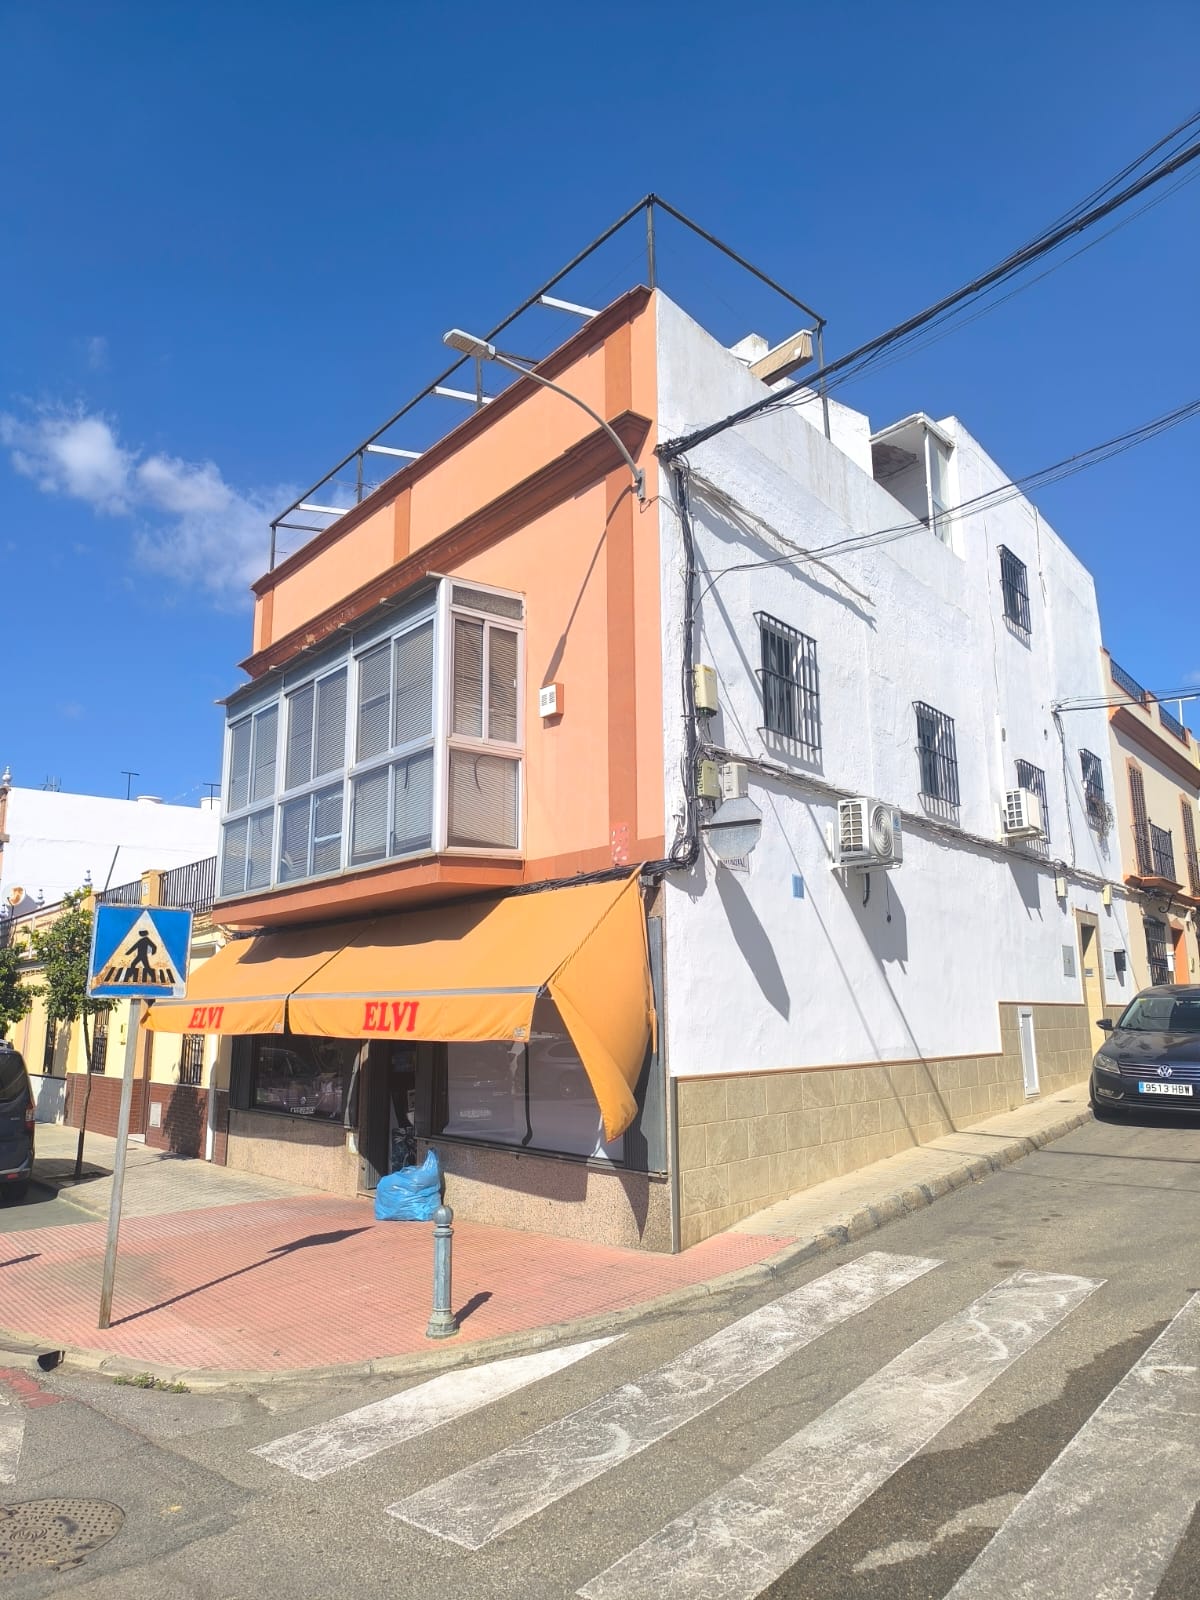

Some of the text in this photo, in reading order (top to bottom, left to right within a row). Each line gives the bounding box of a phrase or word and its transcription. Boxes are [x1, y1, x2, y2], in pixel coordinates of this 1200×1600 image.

[189, 1006, 224, 1029] ELVI
[362, 1001, 420, 1032] ELVI
[1146, 1084, 1190, 1095] 9513 HBW
